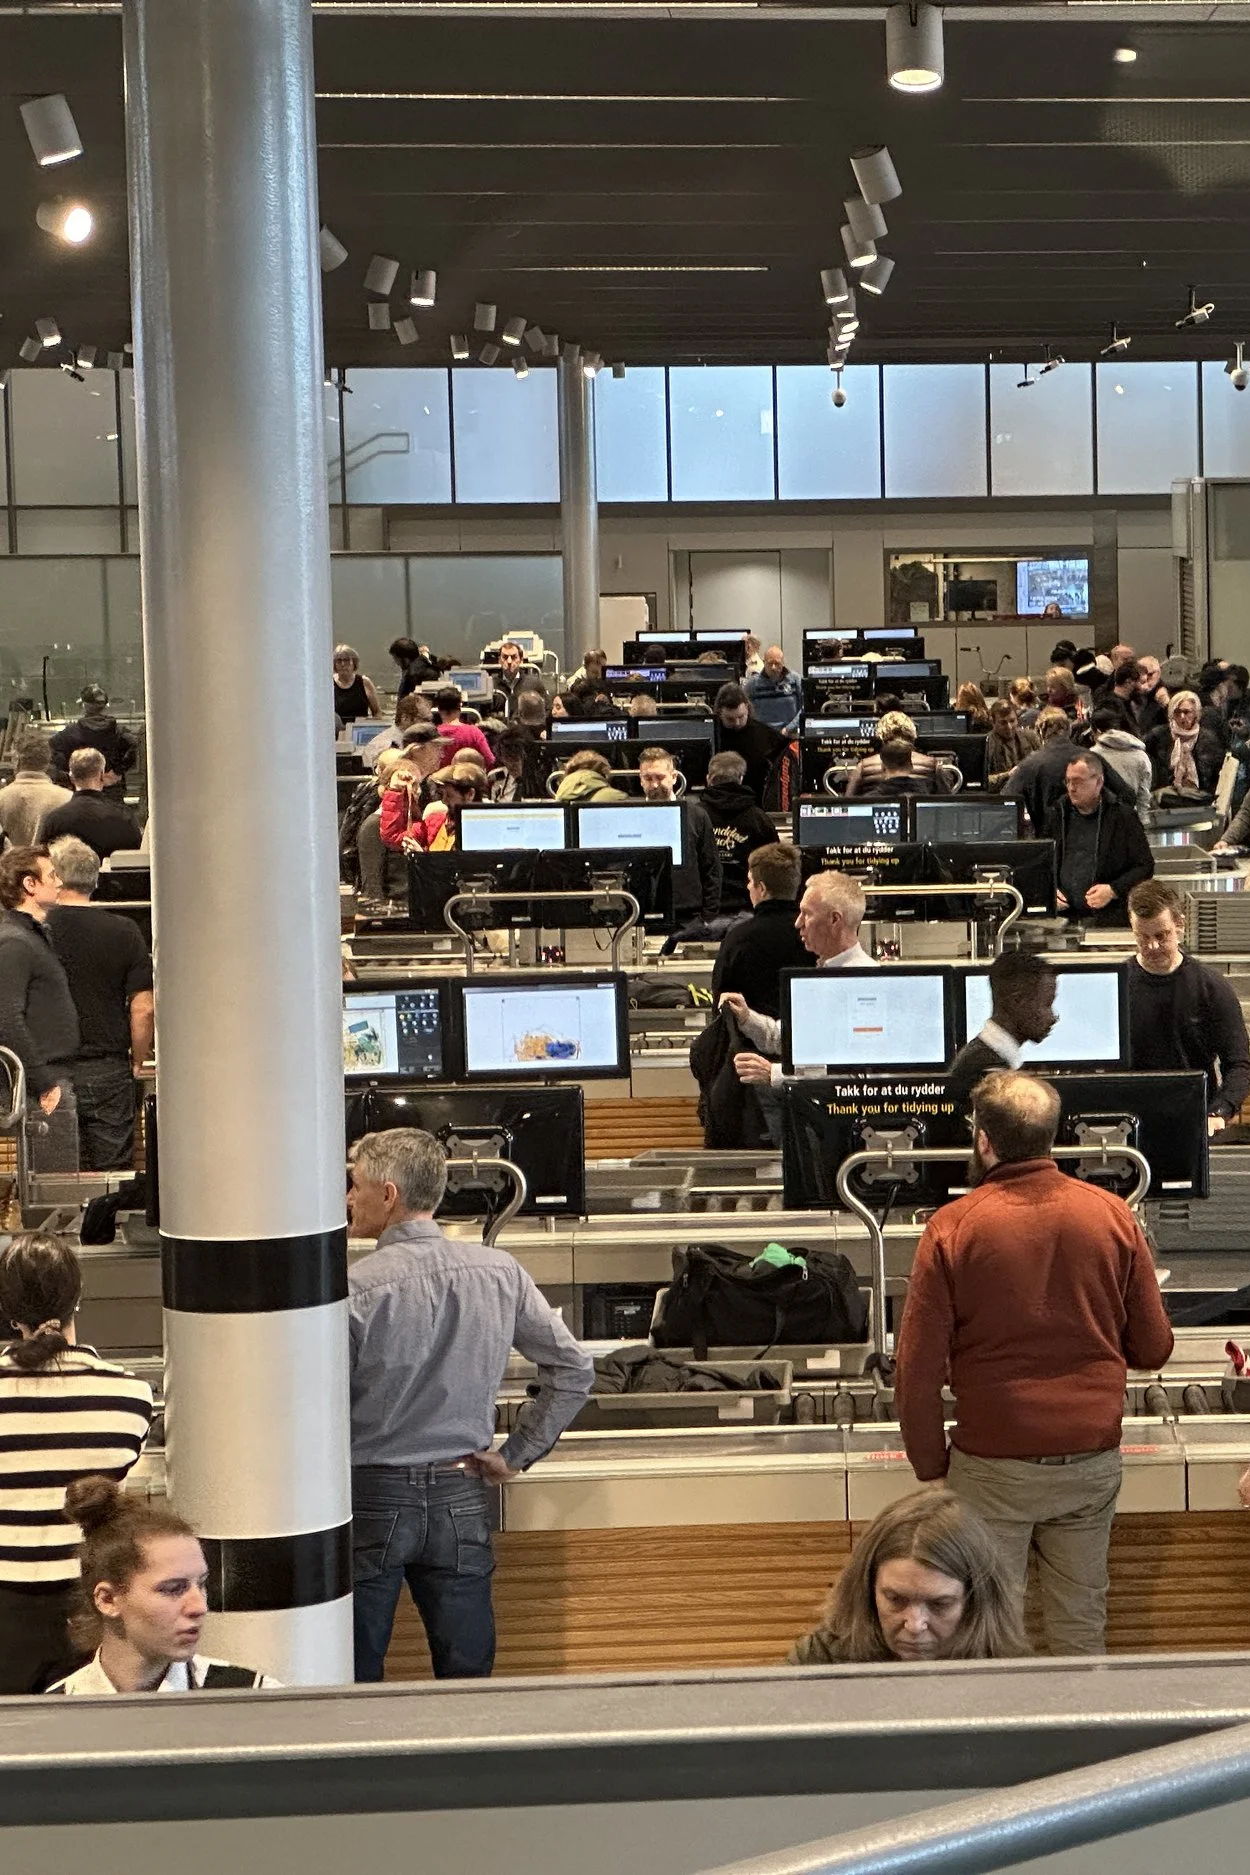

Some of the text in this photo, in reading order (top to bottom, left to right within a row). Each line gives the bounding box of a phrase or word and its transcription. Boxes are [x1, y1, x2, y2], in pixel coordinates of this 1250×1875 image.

[826, 846, 841, 855] Takk
[843, 845, 852, 854] for
[854, 846, 861, 854] at
[862, 846, 871, 854] du
[835, 1083, 945, 1097] Takk for at du rydder
[826, 1101, 954, 1116] Thank you for tidying up
